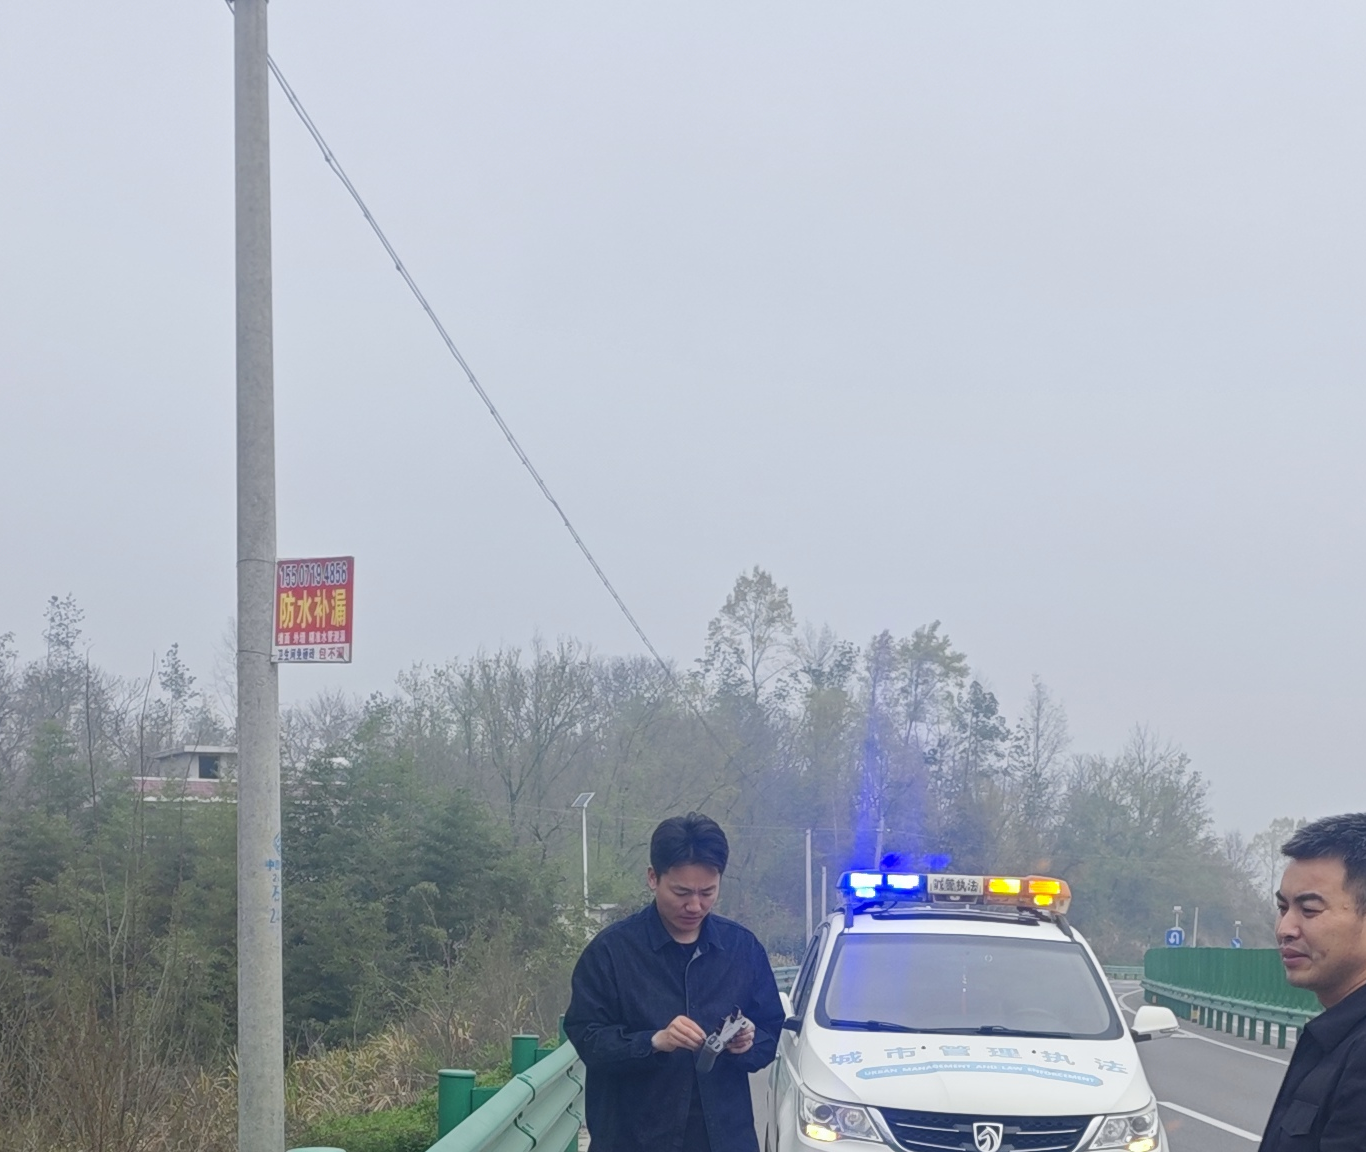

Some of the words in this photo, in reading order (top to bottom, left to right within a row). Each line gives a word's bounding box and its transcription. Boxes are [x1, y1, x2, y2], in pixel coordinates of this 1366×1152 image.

[279, 564, 297, 588] 155
[298, 563, 322, 587] 0719
[323, 561, 347, 586] 4856
[279, 589, 346, 629] 防水补漏
[829, 1045, 1129, 1075] 城市管理执法
[864, 1068, 898, 1076] URBAN
[902, 1063, 972, 1072] MANAGEMENT
[1026, 1067, 1095, 1083] ENFORCEMENT
